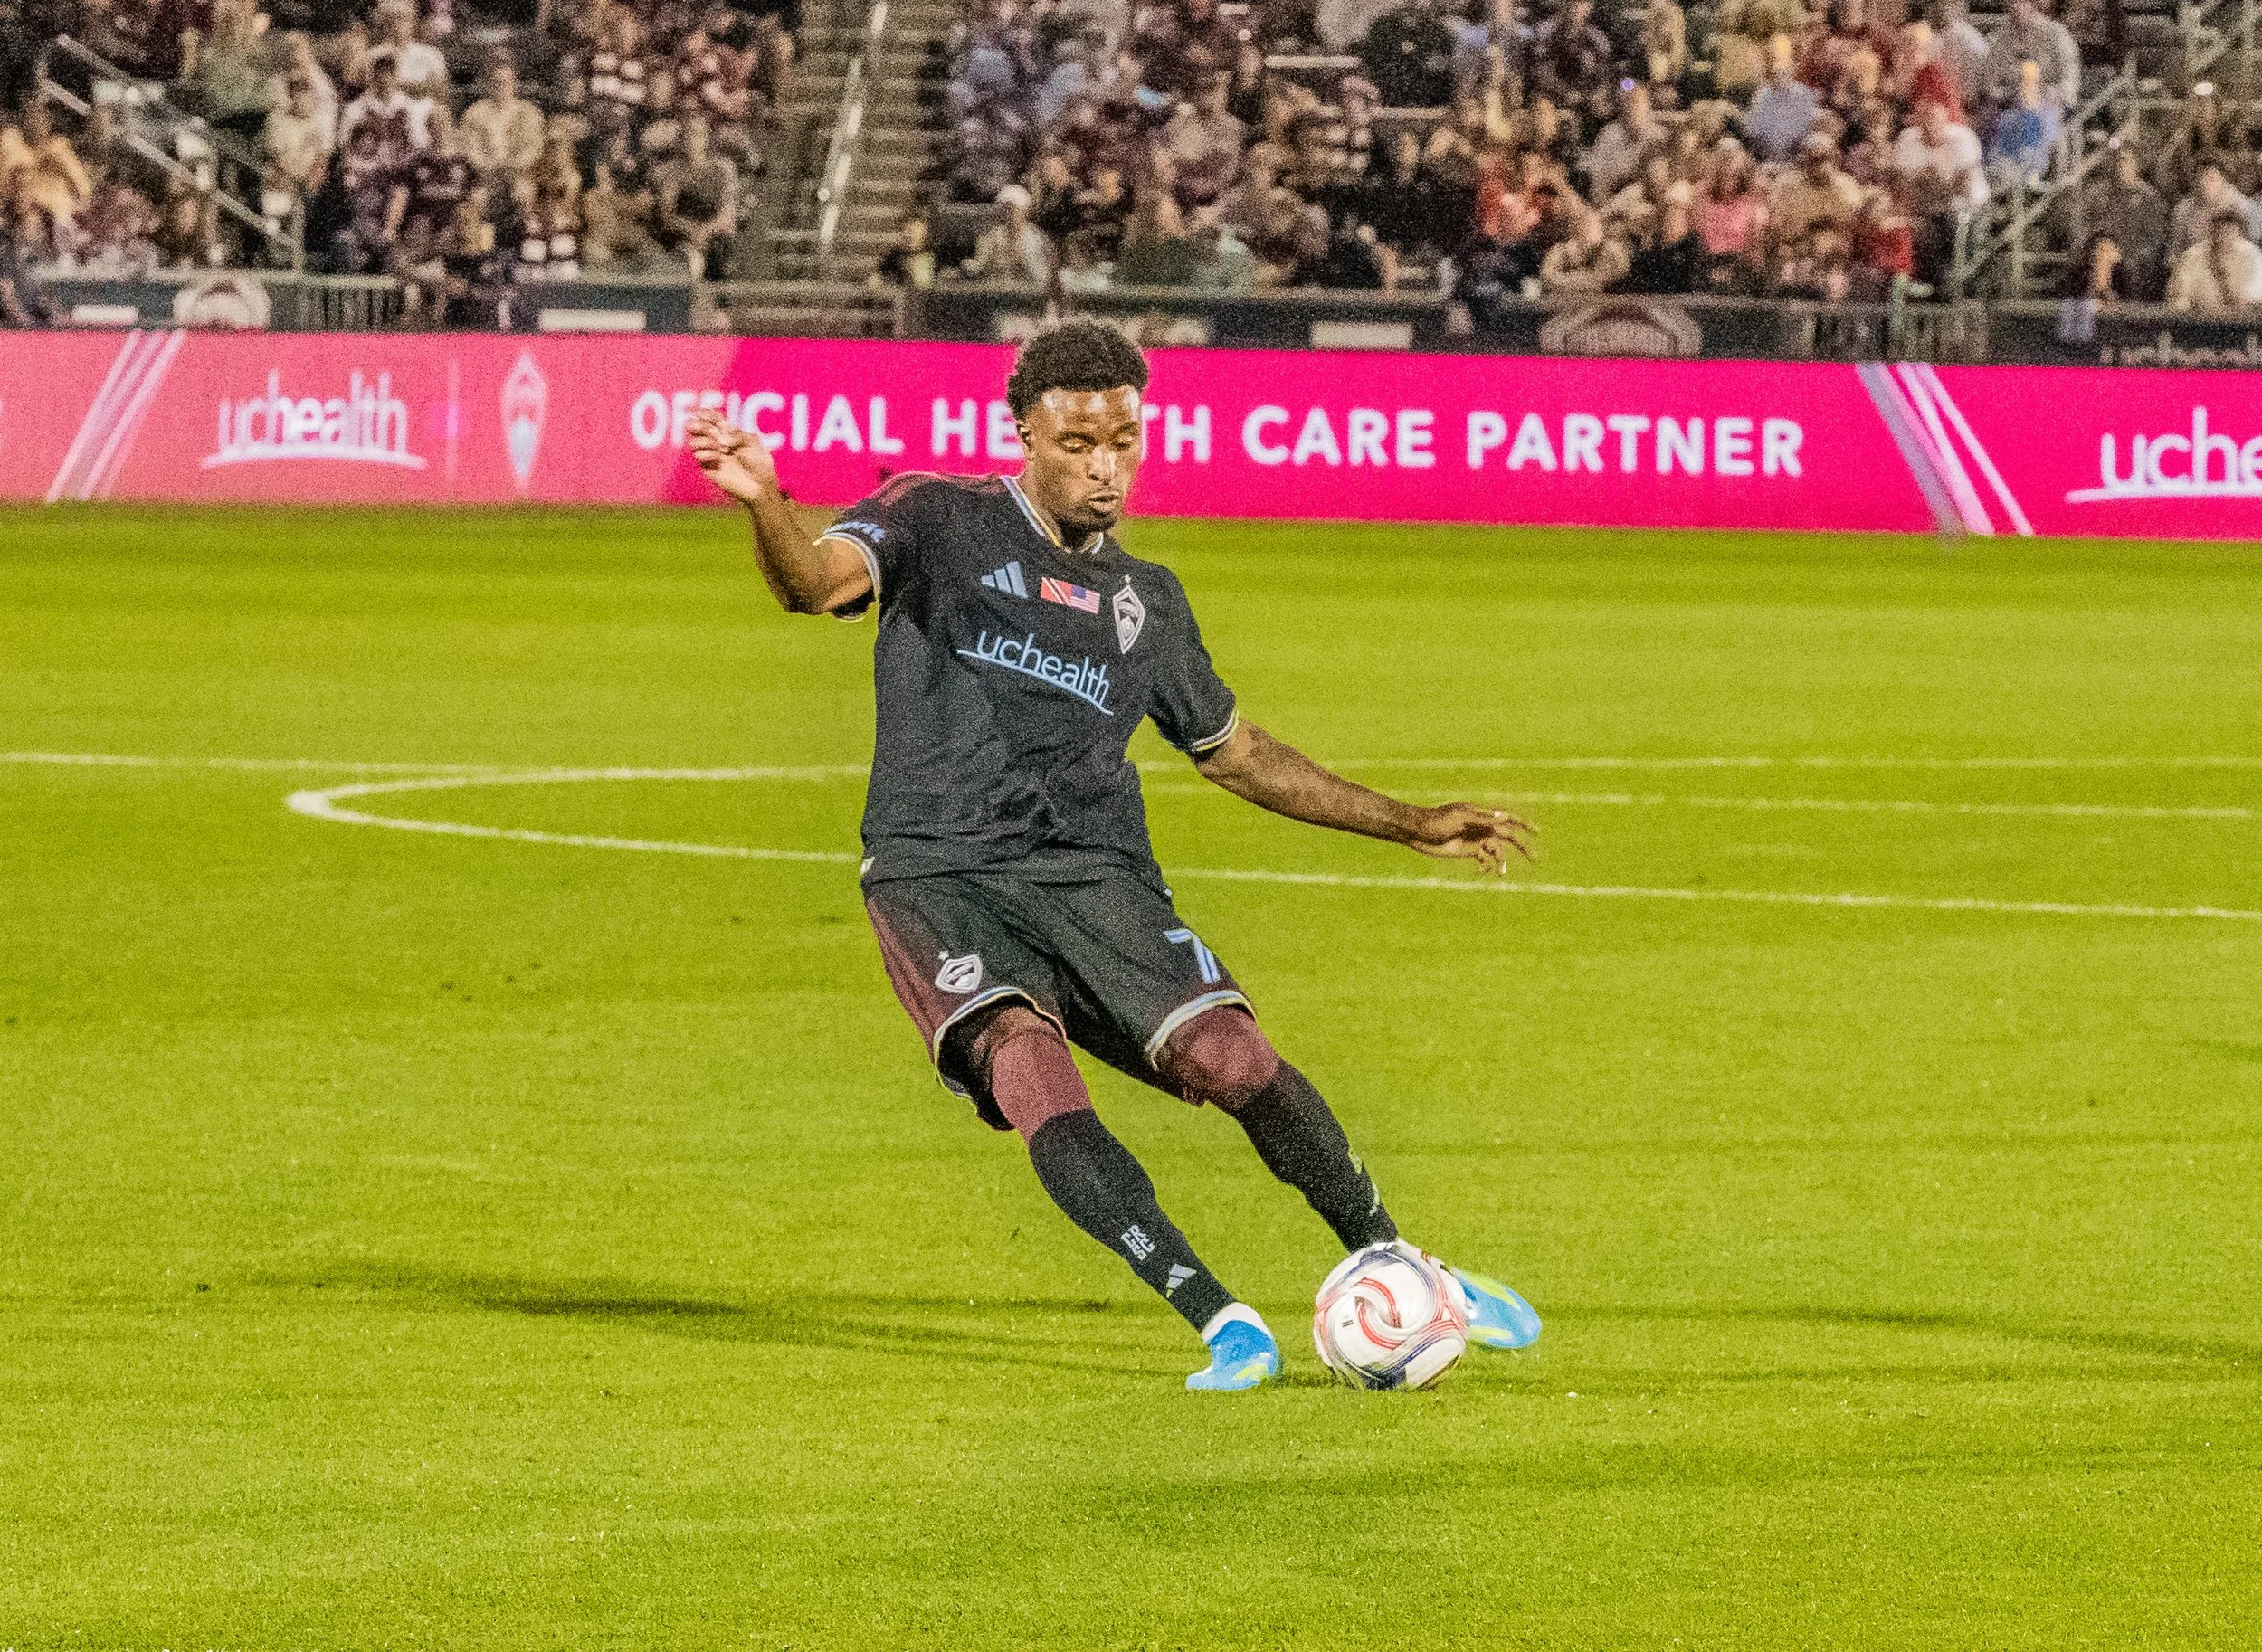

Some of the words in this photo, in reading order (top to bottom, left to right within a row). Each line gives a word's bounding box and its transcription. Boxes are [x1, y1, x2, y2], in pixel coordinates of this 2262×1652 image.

[217, 368, 407, 455] uchealth
[931, 396, 1211, 463] HEH
[1241, 404, 1437, 469] CARE
[1466, 410, 1804, 478] PARTNER
[976, 630, 1110, 706] uchealth
[1164, 928, 1221, 985] 7
